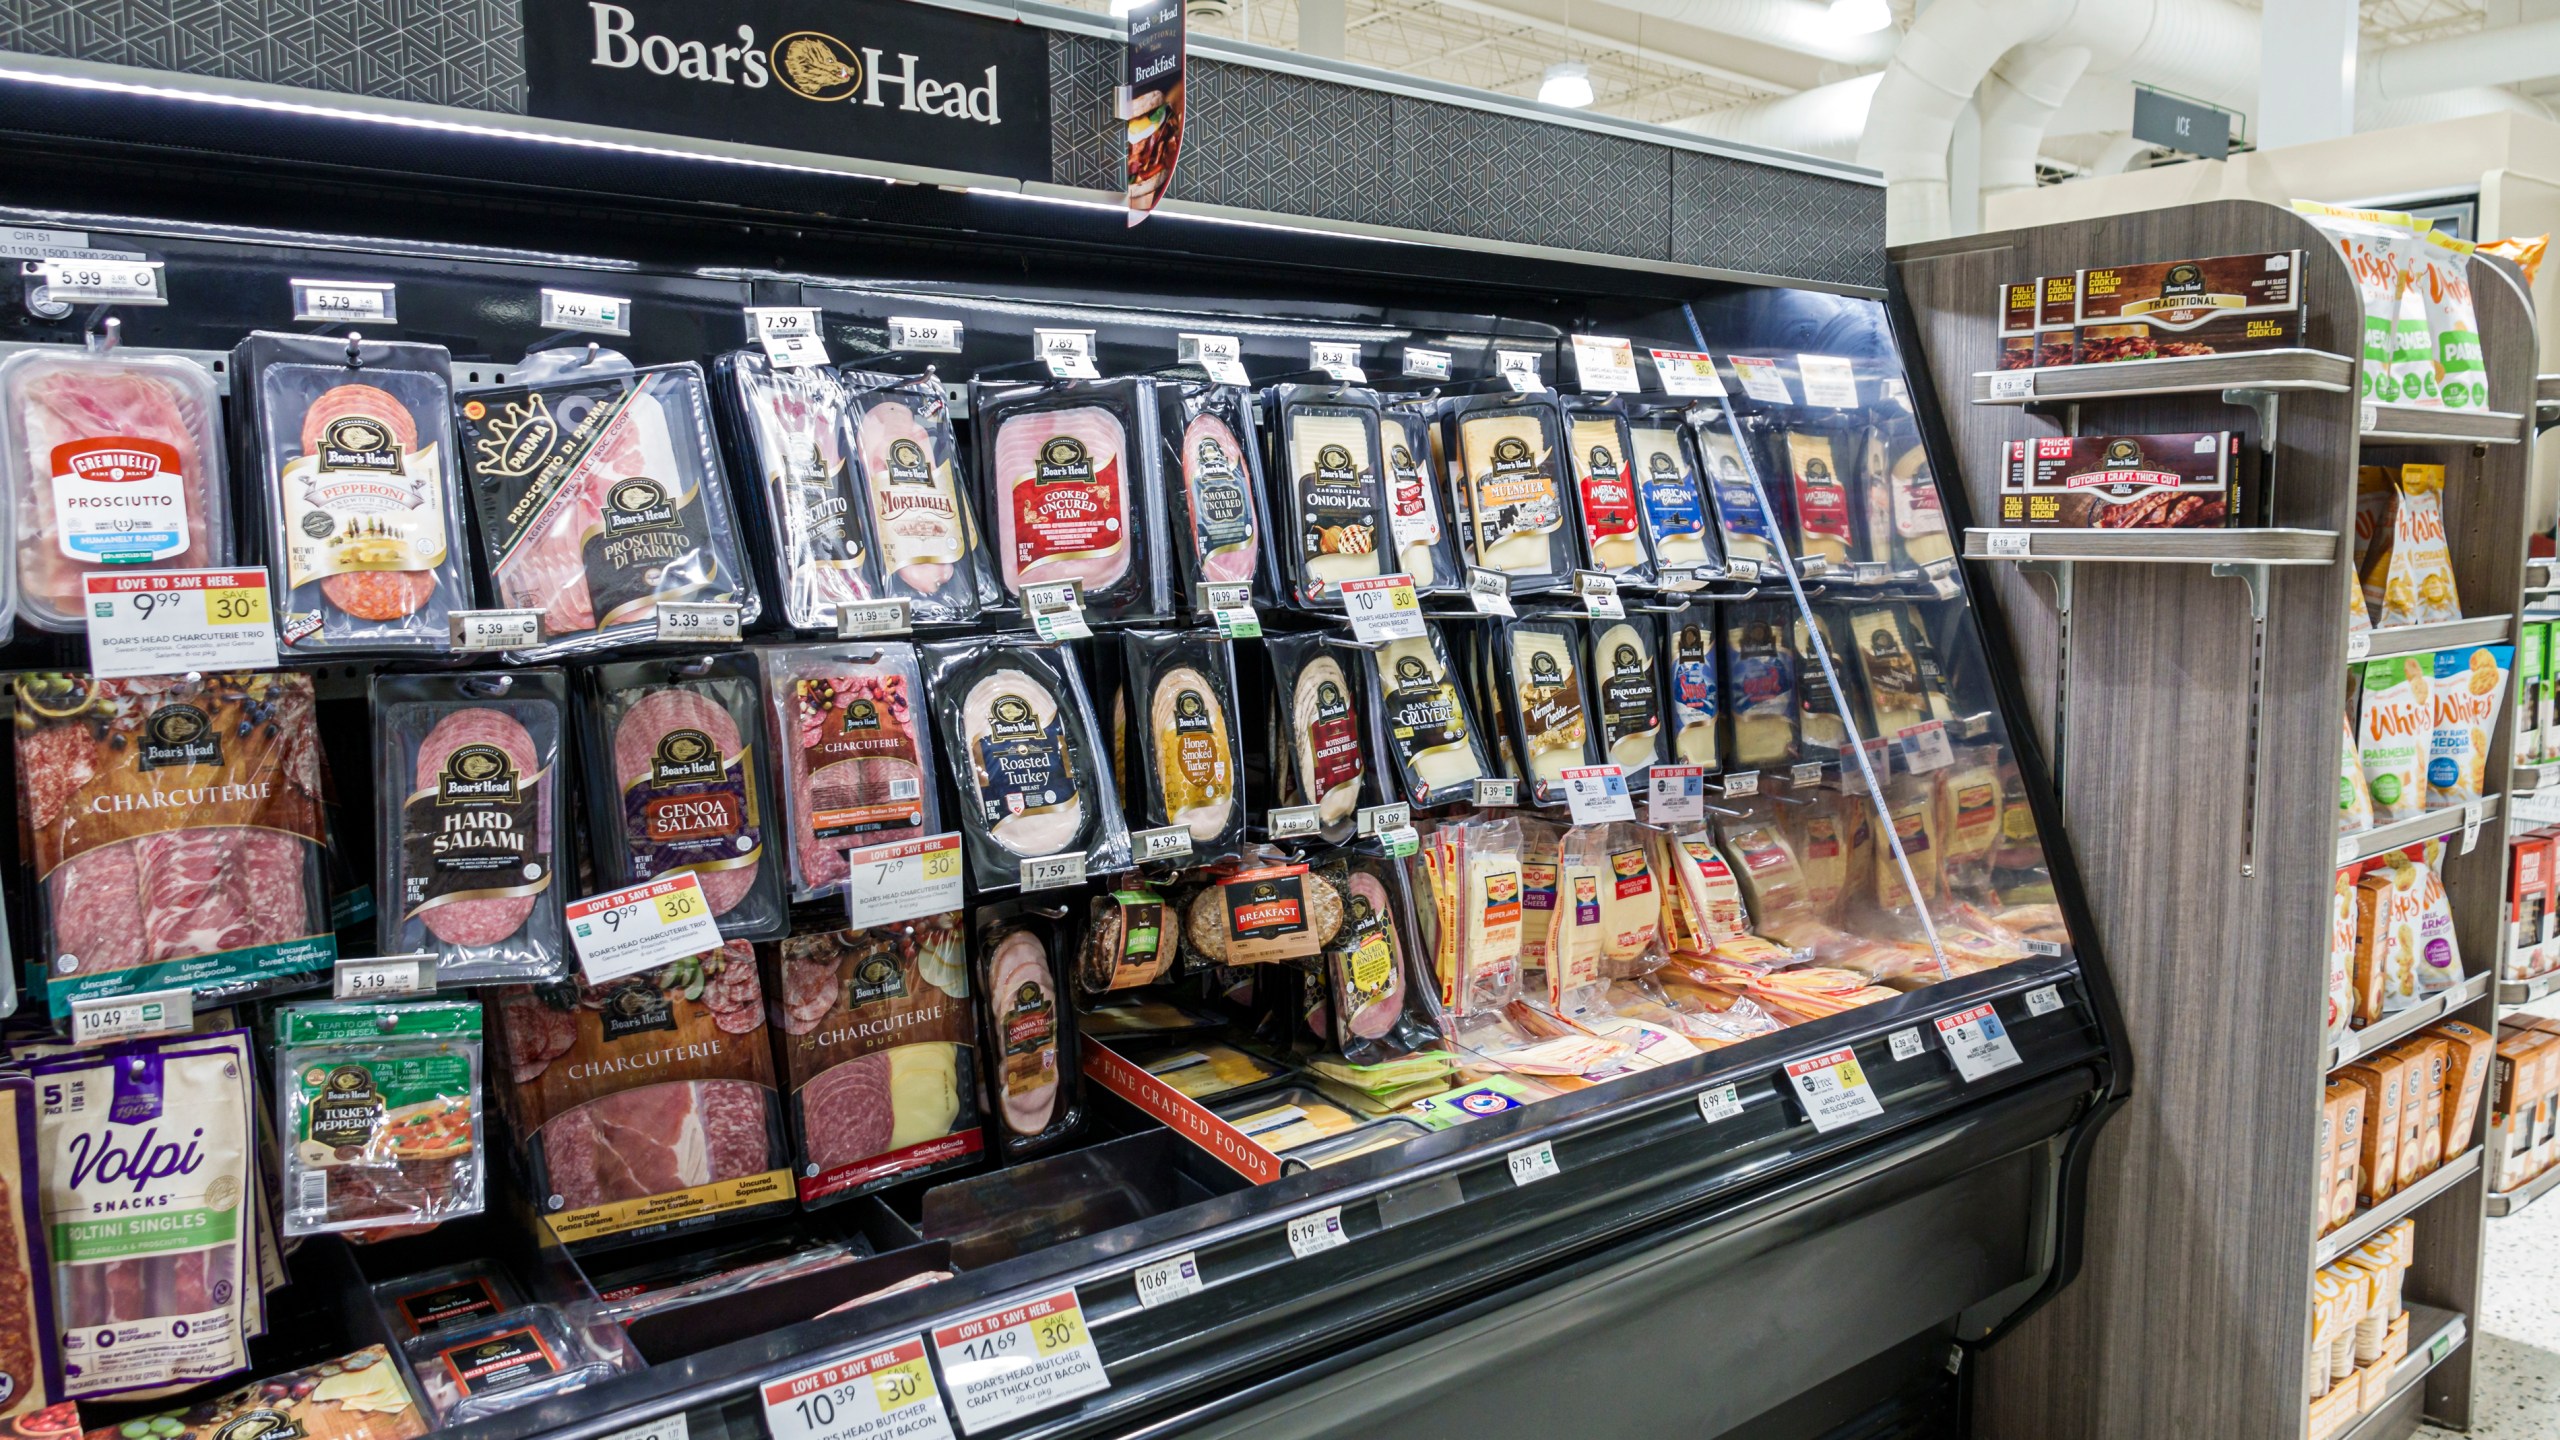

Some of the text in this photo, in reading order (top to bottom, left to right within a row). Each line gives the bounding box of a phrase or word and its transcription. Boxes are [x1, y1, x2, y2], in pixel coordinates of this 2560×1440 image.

[1132, 4, 1177, 36] Boar's Head
[589, 2, 1001, 125] Boar's Head
[1136, 54, 1175, 82] Breakfast
[2176, 116, 2191, 137] ICE
[14, 232, 50, 241] CIR 51
[62, 271, 101, 285] 5.99
[2090, 270, 2114, 280] FULLY
[2048, 278, 2072, 289] FULLY
[2089, 278, 2121, 287] COOKED
[2089, 286, 2116, 295] BACON
[319, 295, 350, 310] 5.79
[557, 303, 586, 316] 9.49
[2148, 296, 2217, 310] TRADITIONAL
[765, 316, 798, 329] 7.99
[2247, 320, 2274, 330] FULLY
[910, 328, 938, 339] 5.89
[2247, 328, 2282, 338] COOKED
[1204, 342, 1227, 353] 8.29
[1322, 352, 1343, 362] 8.39
[509, 425, 550, 469] PARMA
[2041, 439, 2070, 447] THICK
[2041, 447, 2071, 456] CUT
[76, 454, 155, 472] CREMINELLI
[507, 400, 609, 524] PROSCIUTTO DI PARMA
[2070, 474, 2105, 487] BUTCHER
[2136, 473, 2158, 482] THICK
[2161, 476, 2177, 484] CUT
[323, 484, 407, 502] PEPPERONI
[1045, 490, 1090, 502] COOKED
[1204, 491, 1238, 500] SMOKED
[1491, 482, 1544, 497] MUENSTER
[1591, 484, 1627, 499] AMERICAN
[1652, 488, 1691, 502] AMERICAN
[68, 496, 172, 508] PROSCIUTTO
[880, 491, 953, 516] MORTADELLA
[1039, 499, 1097, 513] UNCURED
[1204, 499, 1241, 511] UNCURED
[1307, 493, 1371, 510] ONION JACK
[2031, 496, 2055, 504] FULLY
[2031, 503, 2060, 511] COOKED
[612, 507, 672, 527] Boar's Head
[1056, 509, 1080, 520] HAM
[1215, 509, 1233, 519] HAM
[2031, 510, 2054, 518] BACON
[116, 575, 239, 590] LOVE TO SAVE HERE.
[669, 614, 699, 627] 5.39
[853, 611, 877, 622] 11.99
[477, 623, 502, 634] 5.39
[103, 630, 264, 646] BOAR'S HEAD CHARCUTERIE TRIO
[1610, 687, 1652, 700] PROVOLONE
[1392, 706, 1456, 726] GRUYERE
[1532, 699, 1555, 722] Vermont
[1545, 705, 1567, 730] Cheddar
[148, 742, 214, 760] Boar's Head
[825, 738, 900, 753] CHARCUTERIE
[1184, 737, 1209, 751] Honey
[1317, 739, 1358, 759] CHICKEN BREAST
[1182, 749, 1212, 760] Smoked
[1000, 753, 1051, 771] Roasted
[1185, 759, 1212, 773] Turkey
[1005, 769, 1050, 786] Turkey
[447, 779, 510, 795] Boar's Head
[1483, 786, 1498, 795] 4.39
[92, 781, 272, 814] CHARCUTERIE
[658, 801, 726, 818] GENOA
[444, 812, 513, 833] HARD
[657, 814, 729, 833] SALAMI
[1282, 821, 1297, 830] 4.49
[1378, 812, 1400, 825] 8.09
[432, 831, 524, 854] SALAMI
[1152, 835, 1178, 848] 4.99
[870, 840, 944, 861] LOVE TO SAVE HERE.
[1038, 865, 1066, 878] 7.59
[1619, 879, 1648, 889] PROVOLONE
[1239, 907, 1297, 924] BREAKFAST
[1487, 909, 1519, 920] PEPPER JACK
[182, 959, 218, 972] Uncured
[1356, 950, 1386, 967] HONEY HAM
[164, 965, 237, 983] Sweet Capocollo
[353, 974, 385, 989] 5.19
[319, 1022, 341, 1030] TEAR
[357, 1020, 377, 1028] OPE
[610, 1011, 667, 1031] Boar's Head
[818, 1005, 943, 1046] CHARCUTERIE
[317, 1031, 331, 1039] ZIP
[333, 1030, 344, 1038] TO
[568, 1039, 722, 1080] CHARCUTERIE
[44, 1085, 62, 1105] 5
[327, 1090, 370, 1100] Boar's Head
[45, 1106, 63, 1115] PACK
[325, 1106, 371, 1119] TURKEY
[1103, 1061, 1268, 1177] FINE CRAFTED FOODS
[913, 1137, 964, 1157] Smoked Gouda
[69, 1127, 204, 1193] Volpi
[736, 1182, 778, 1197] Sopressata
[739, 1177, 772, 1190] Uncured
[129, 1213, 207, 1233] SINGLES
[567, 1210, 600, 1224] Uncured
[602, 1285, 641, 1300] EXTRA
[792, 1354, 900, 1396] LOVE TO SAVE HERE.
[967, 1350, 1082, 1395] BOAR'S HEAD BUTCHER
[966, 1361, 1092, 1409] CRAFT THICK CUT BACON
